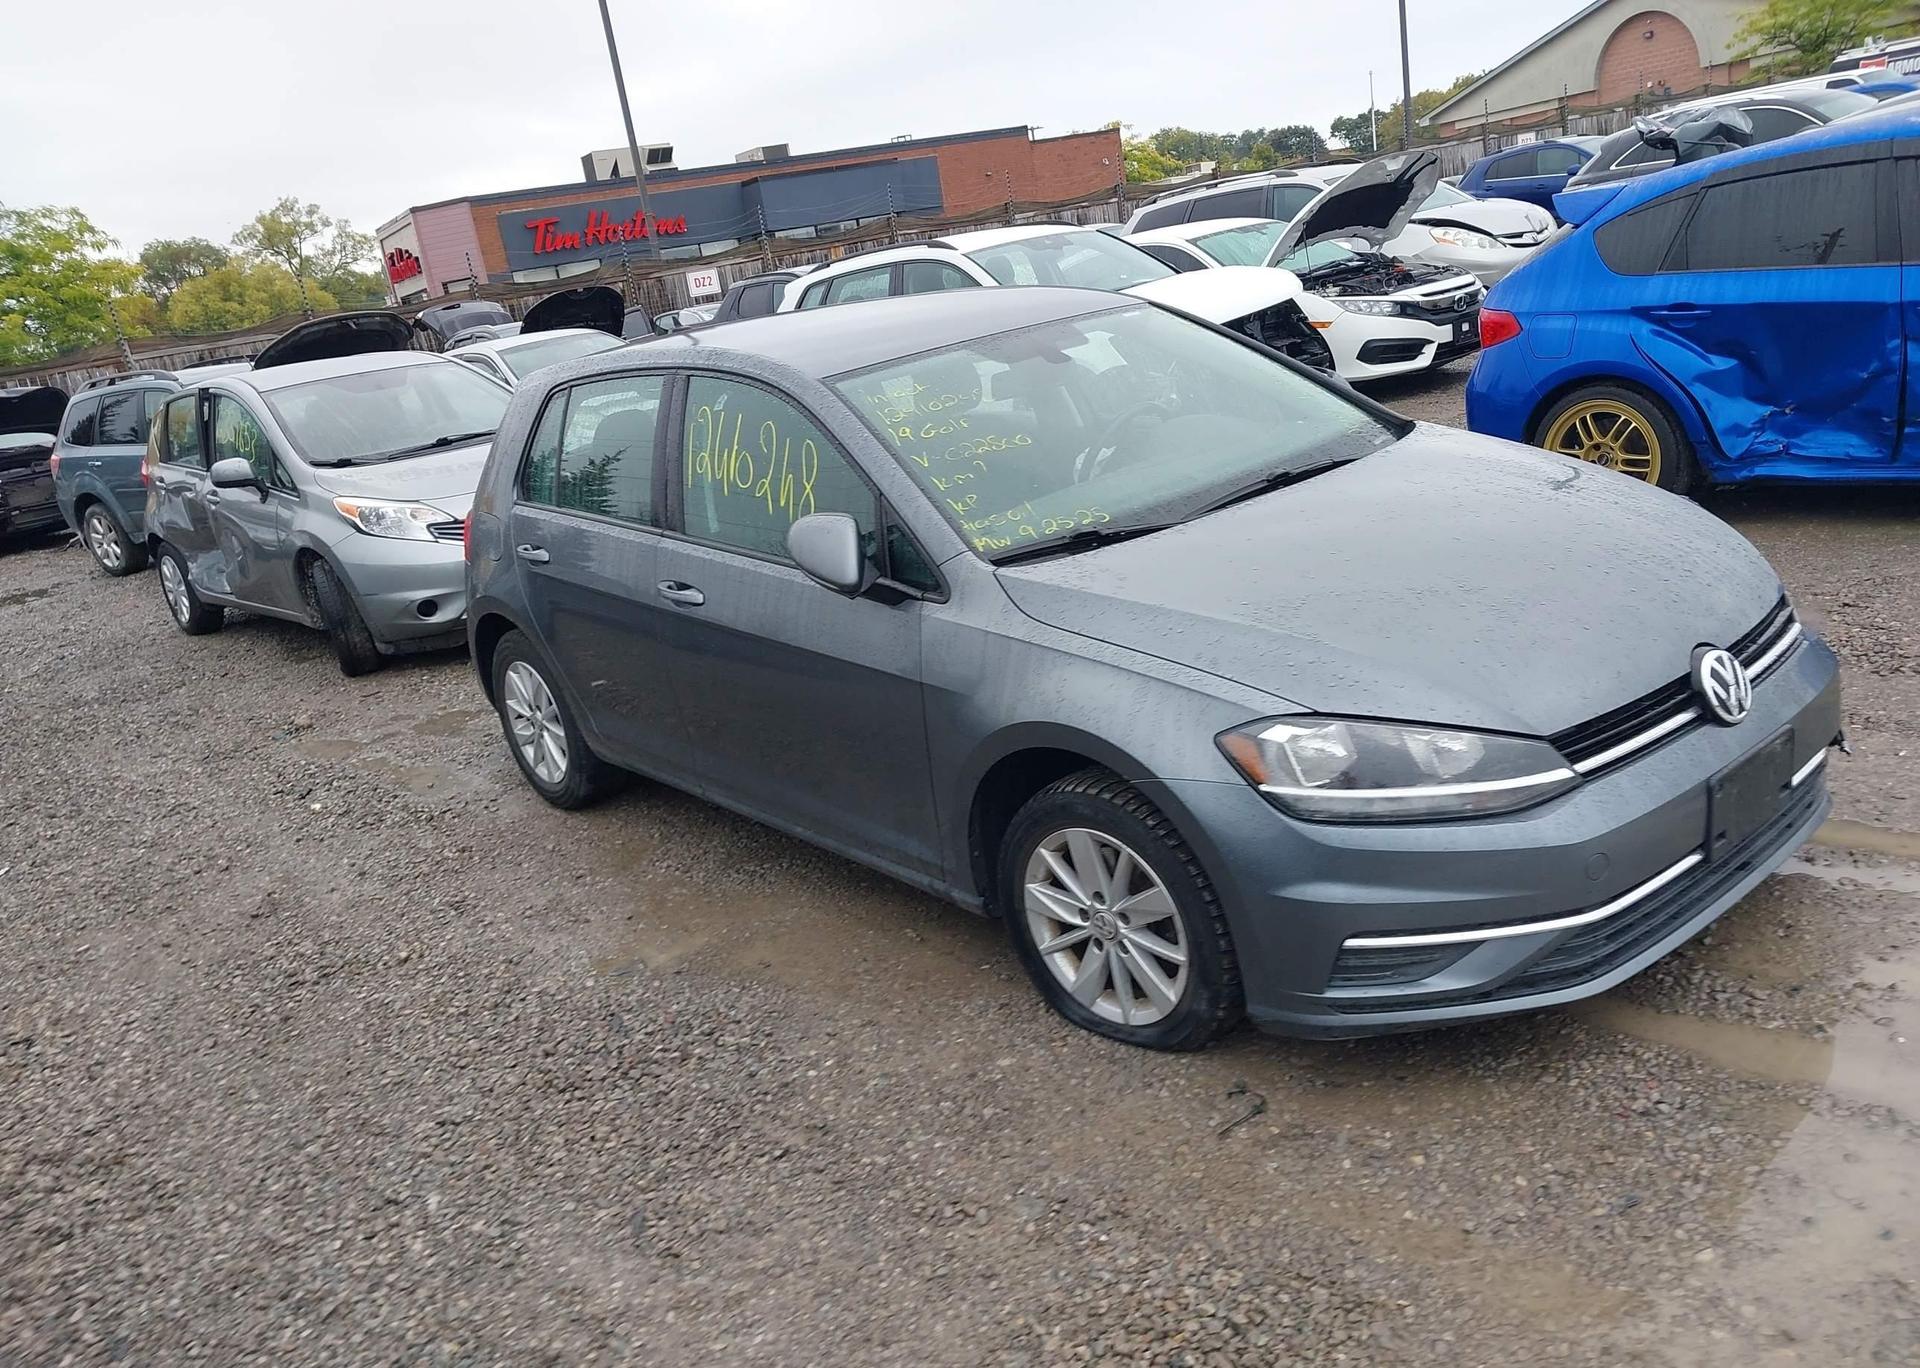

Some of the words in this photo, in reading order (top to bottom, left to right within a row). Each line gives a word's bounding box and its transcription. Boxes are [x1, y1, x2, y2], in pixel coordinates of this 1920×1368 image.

[525, 217, 581, 254] Tim
[584, 208, 687, 247] Hortns
[693, 275, 713, 289] DZ2
